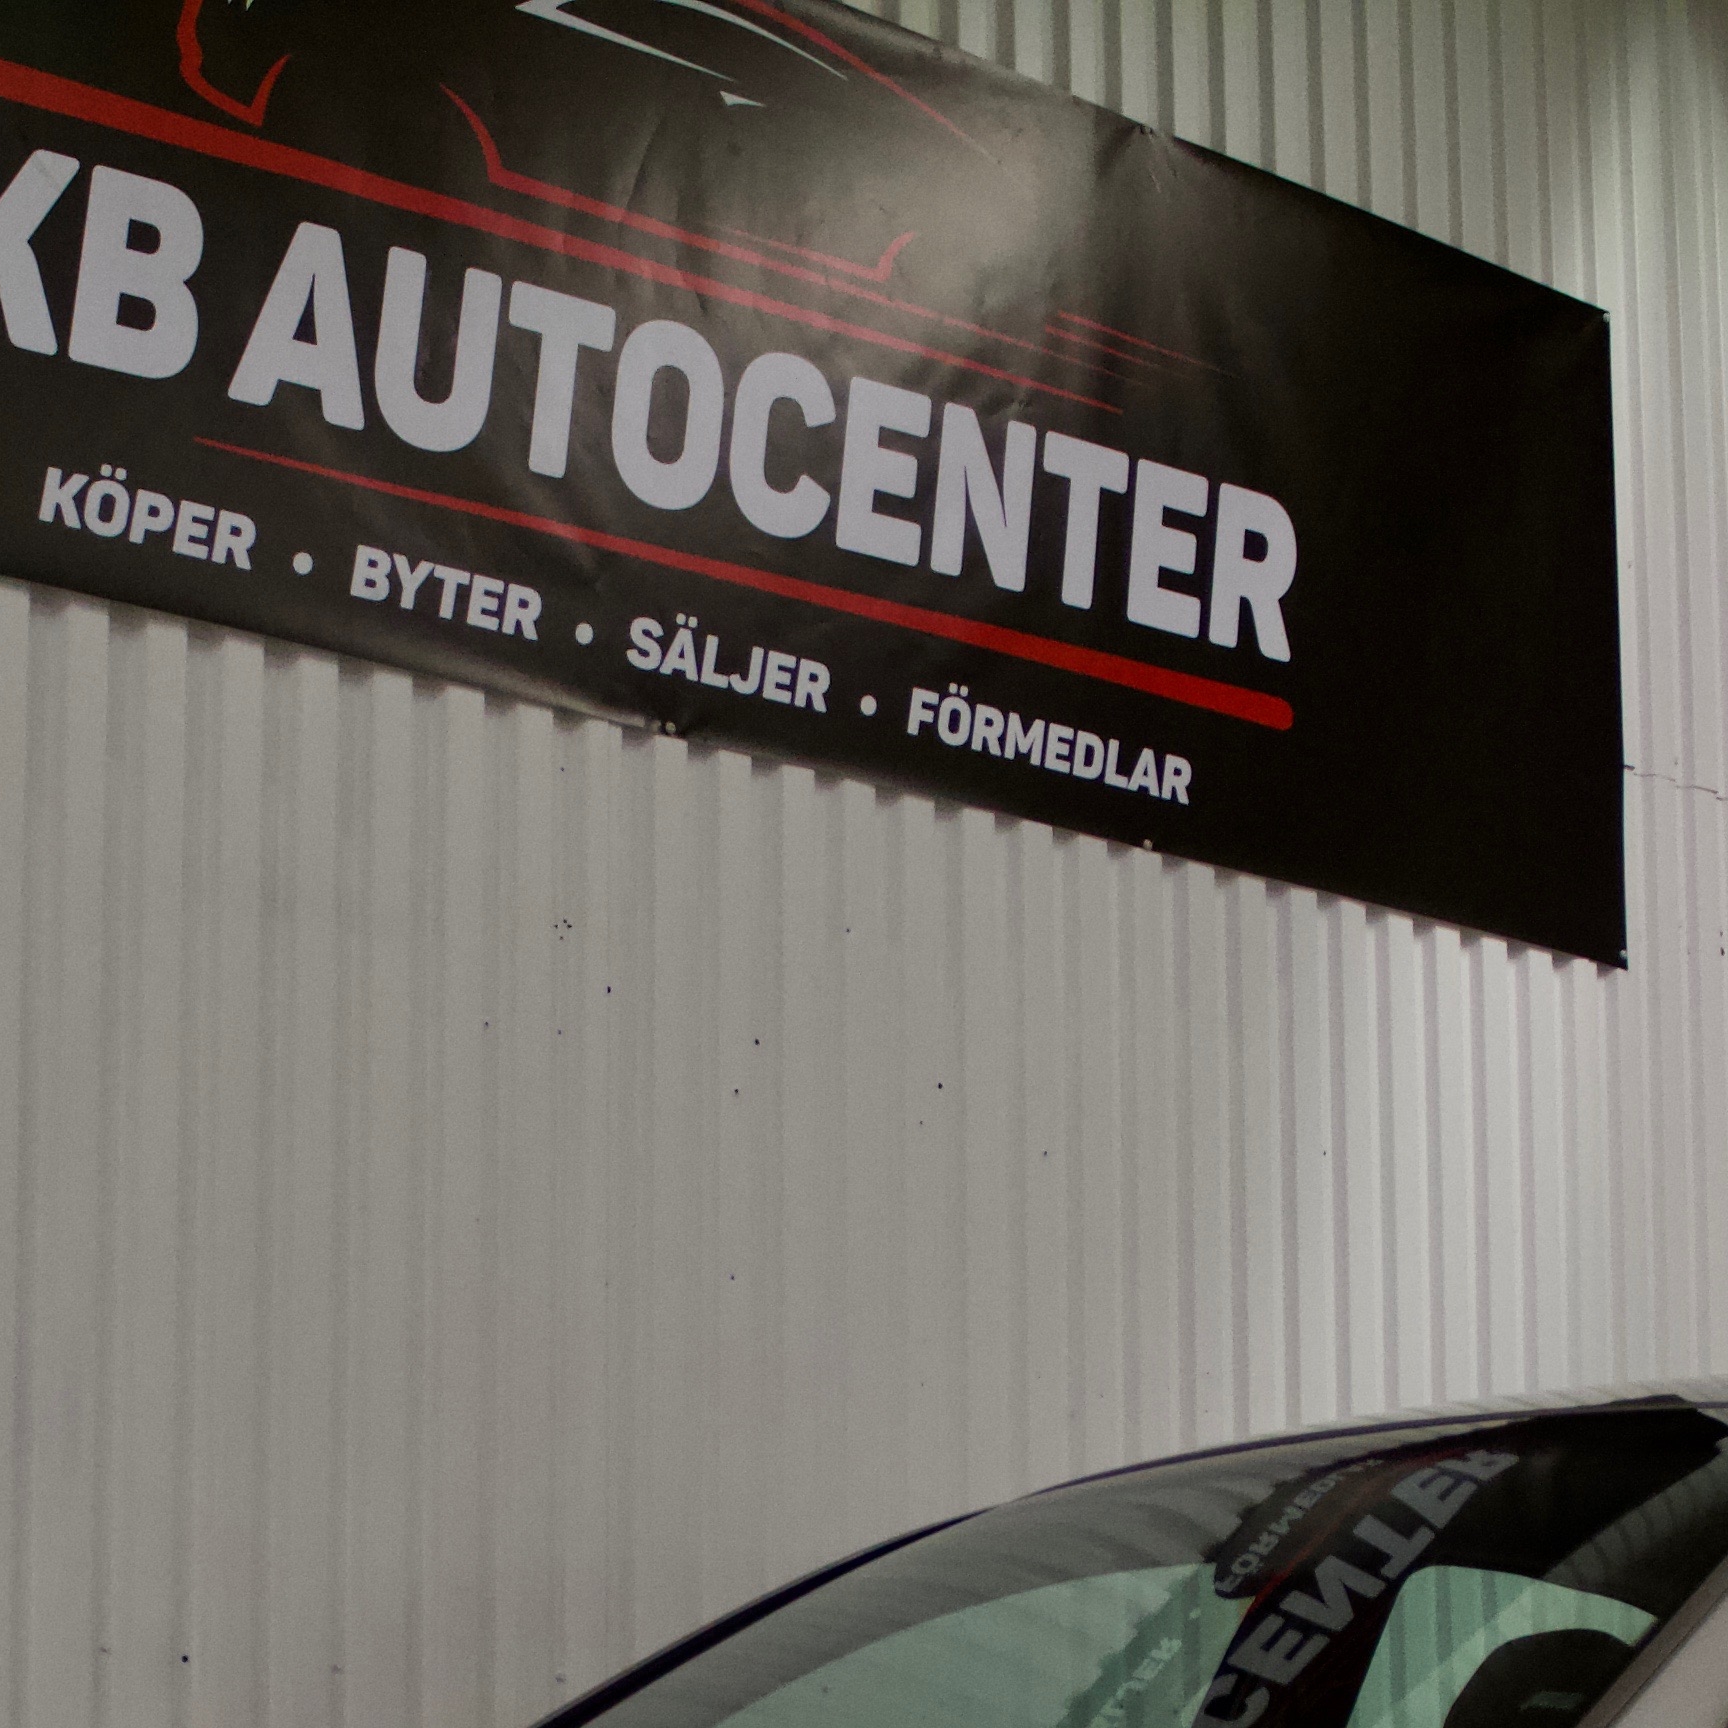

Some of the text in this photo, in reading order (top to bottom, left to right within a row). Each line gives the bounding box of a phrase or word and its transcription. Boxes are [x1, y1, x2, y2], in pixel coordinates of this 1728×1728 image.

[38, 462, 1193, 806] KÖPER BYTER SÄLJER FÖRMEDLAR
[227, 220, 1298, 663] AUTOCENTER
